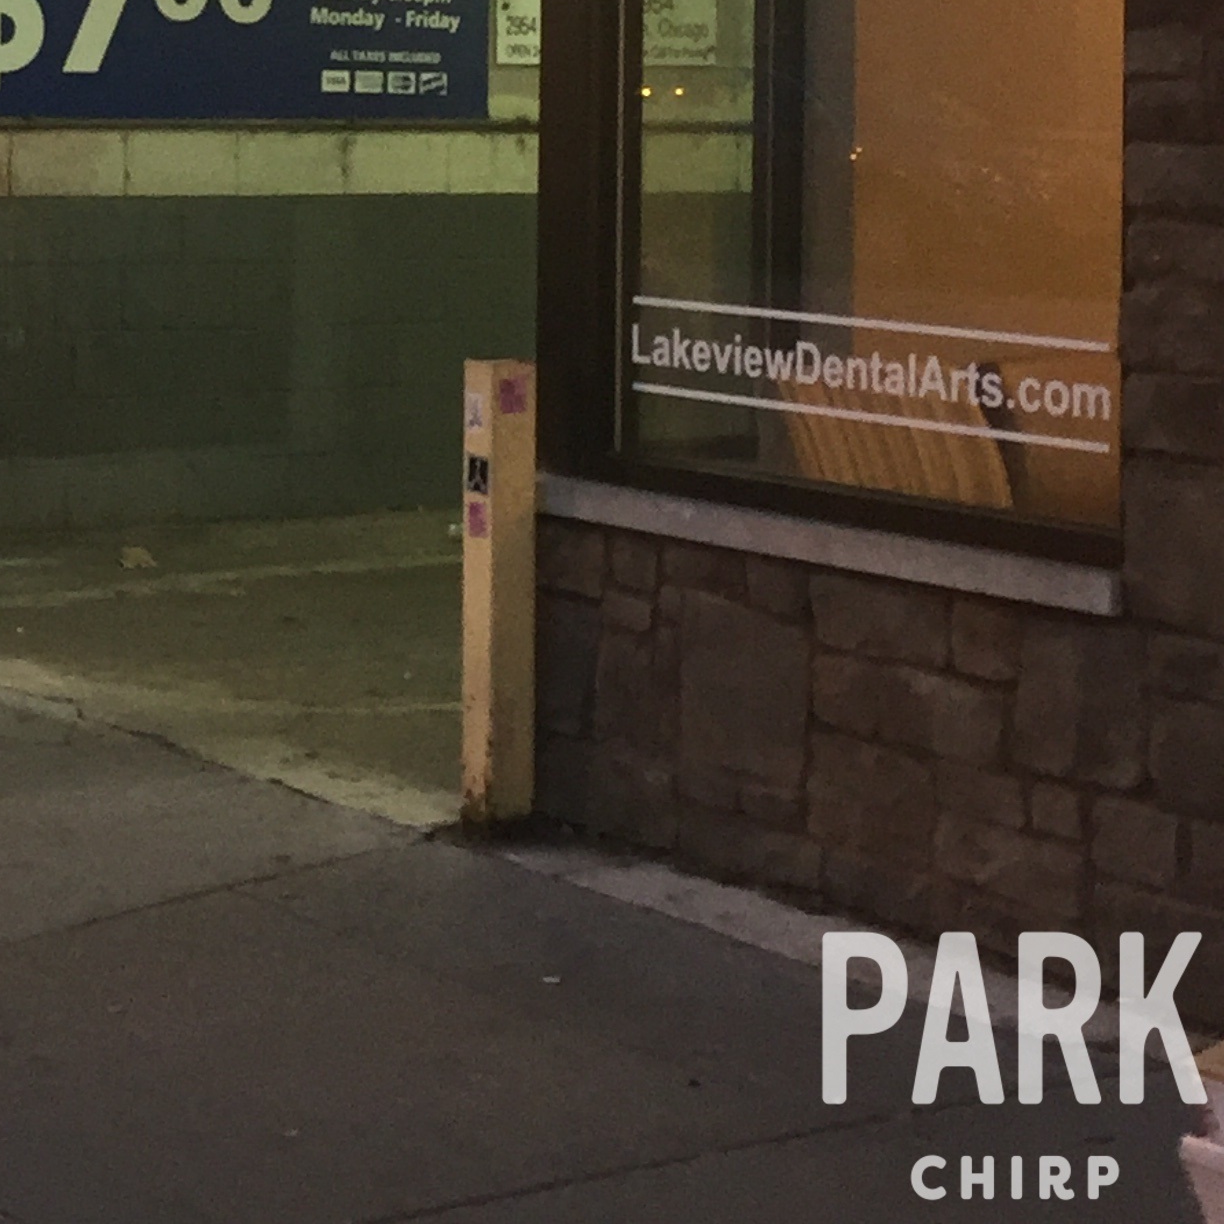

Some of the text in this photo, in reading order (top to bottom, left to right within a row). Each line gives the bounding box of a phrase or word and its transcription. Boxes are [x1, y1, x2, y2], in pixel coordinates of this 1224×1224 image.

[310, 7, 385, 31] Monday
[405, 10, 461, 33] Friday
[631, 324, 1112, 421] LakeviewDentalArts.com
